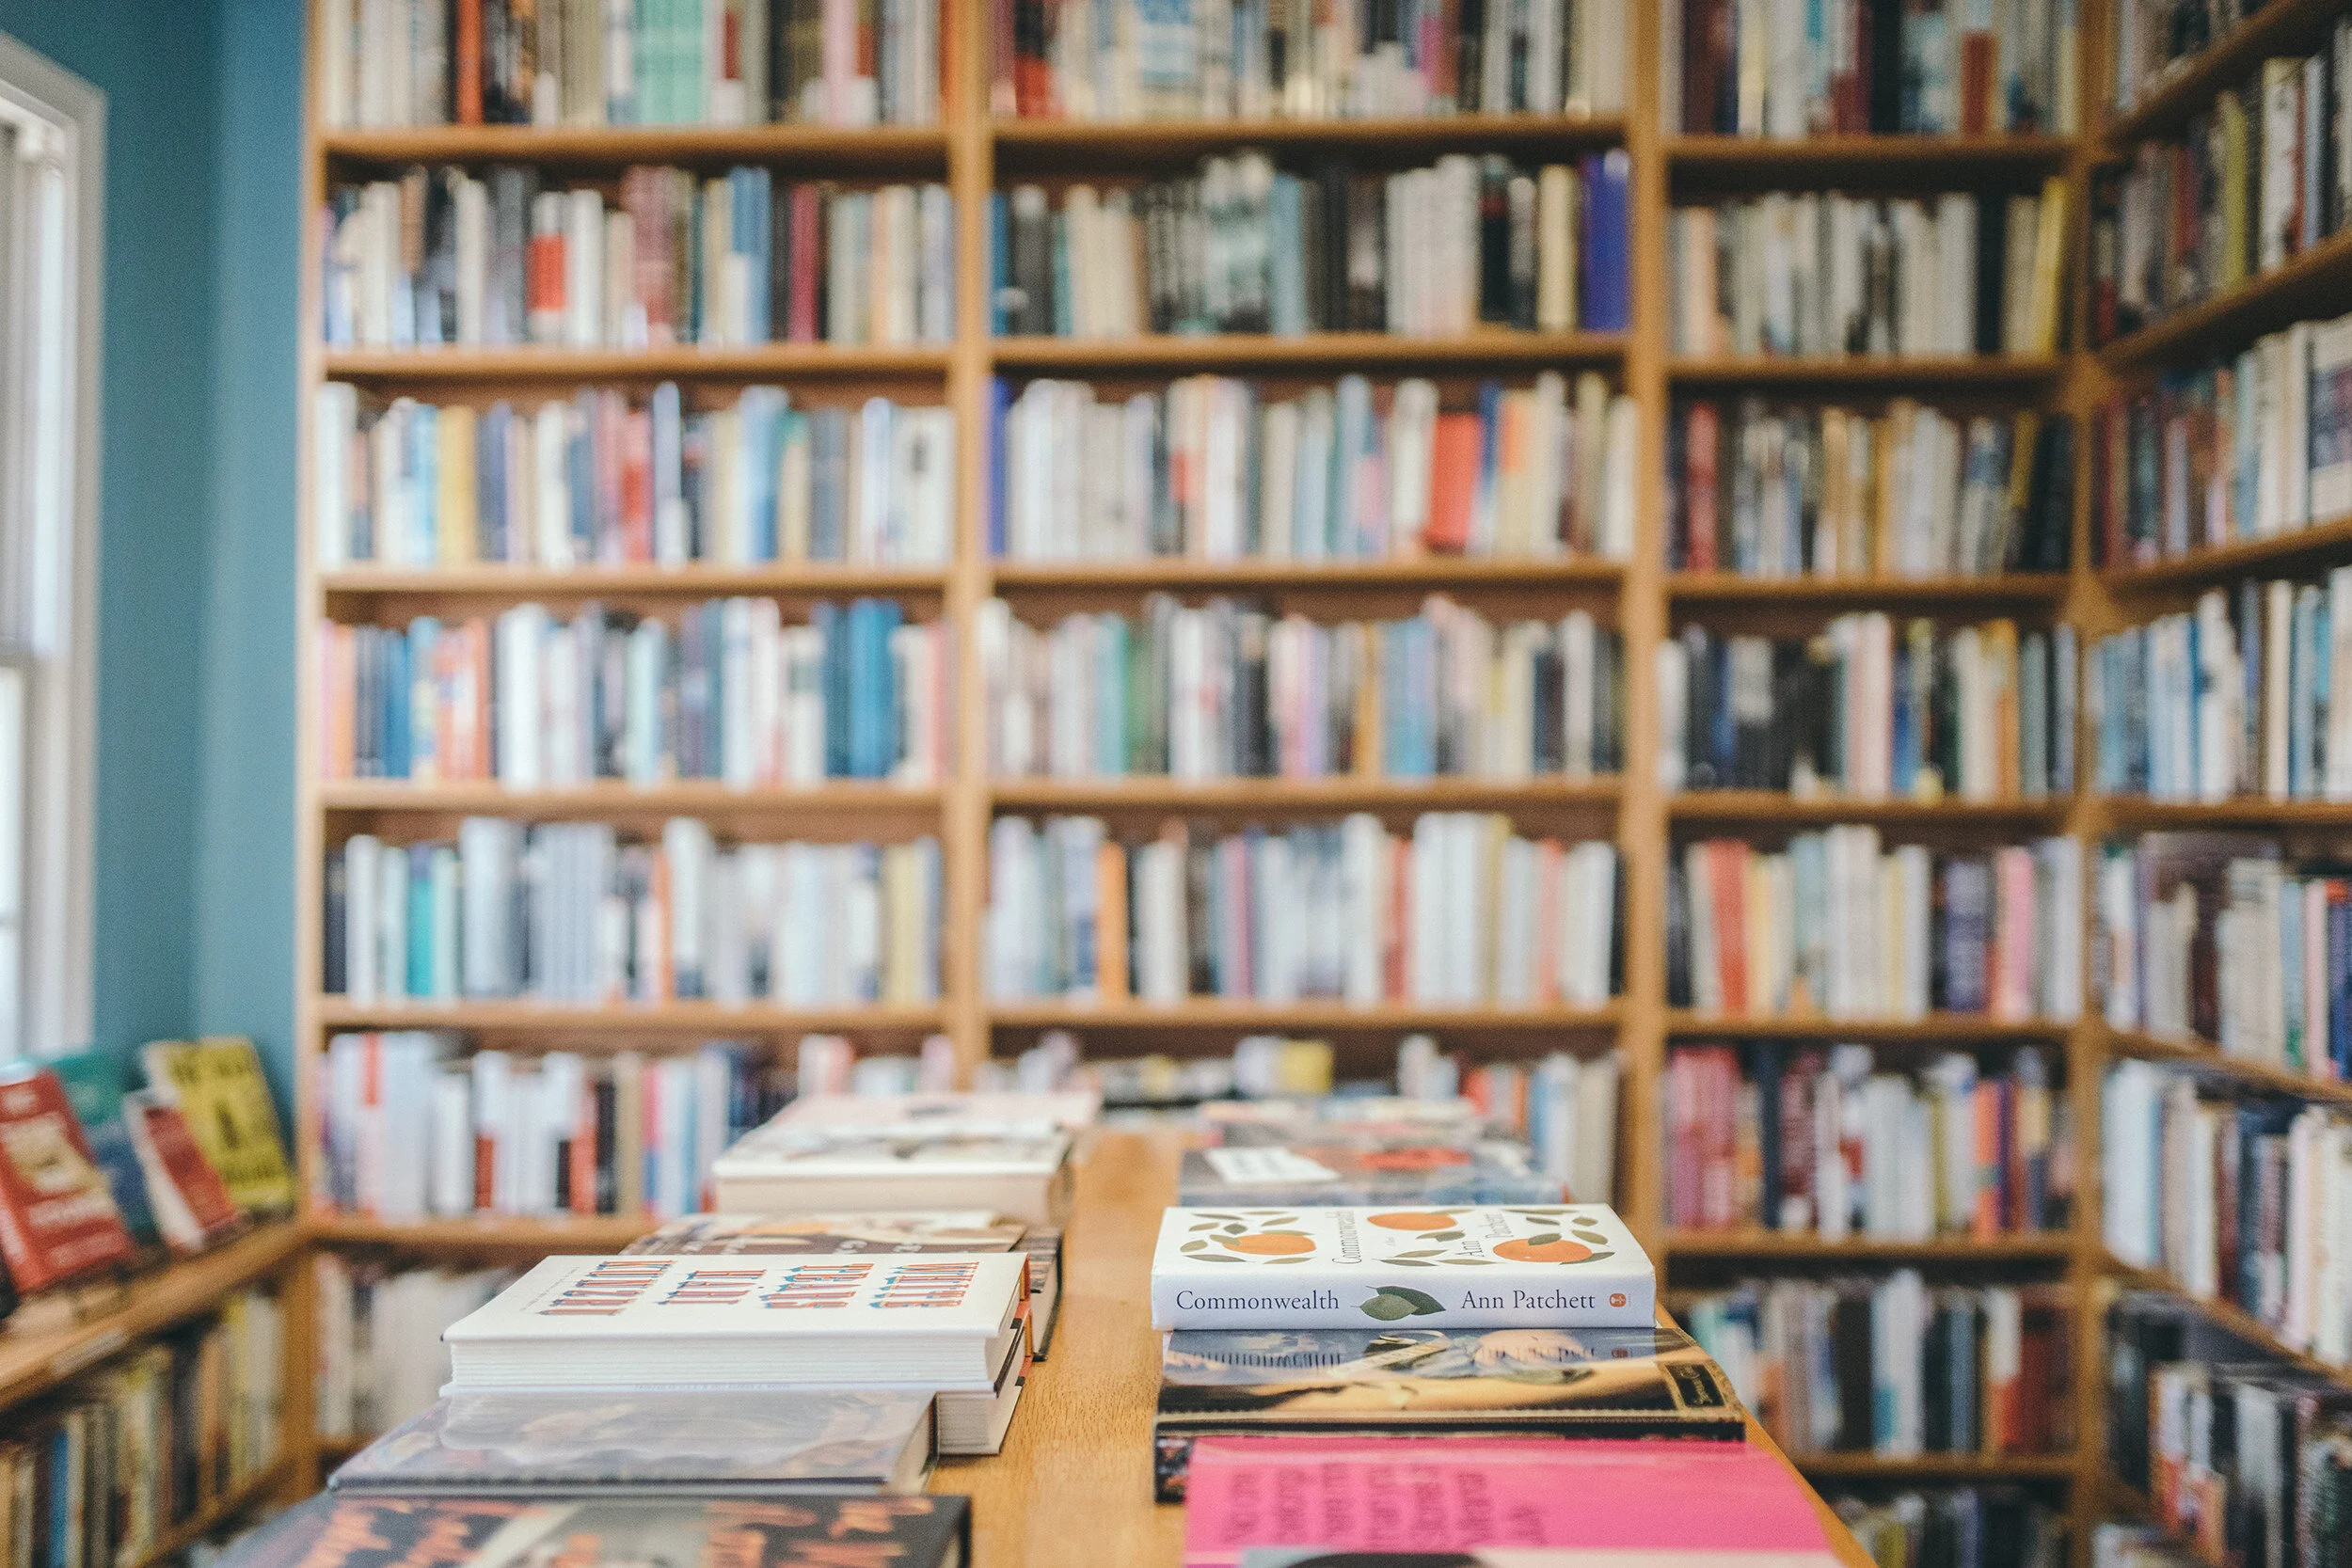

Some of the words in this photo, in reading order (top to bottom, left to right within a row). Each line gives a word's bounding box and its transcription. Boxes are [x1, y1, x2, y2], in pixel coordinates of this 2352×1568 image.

[1456, 1240, 1485, 1258] Ann
[536, 1260, 678, 1315] KUNZRU
[657, 1269, 766, 1306] HARI
[759, 1263, 875, 1308] TEARS
[869, 1261, 979, 1308] WHITE
[1176, 1290, 1339, 1309] Commonwealth
[1461, 1290, 1504, 1309] Ann
[1513, 1289, 1596, 1309] Patchett
